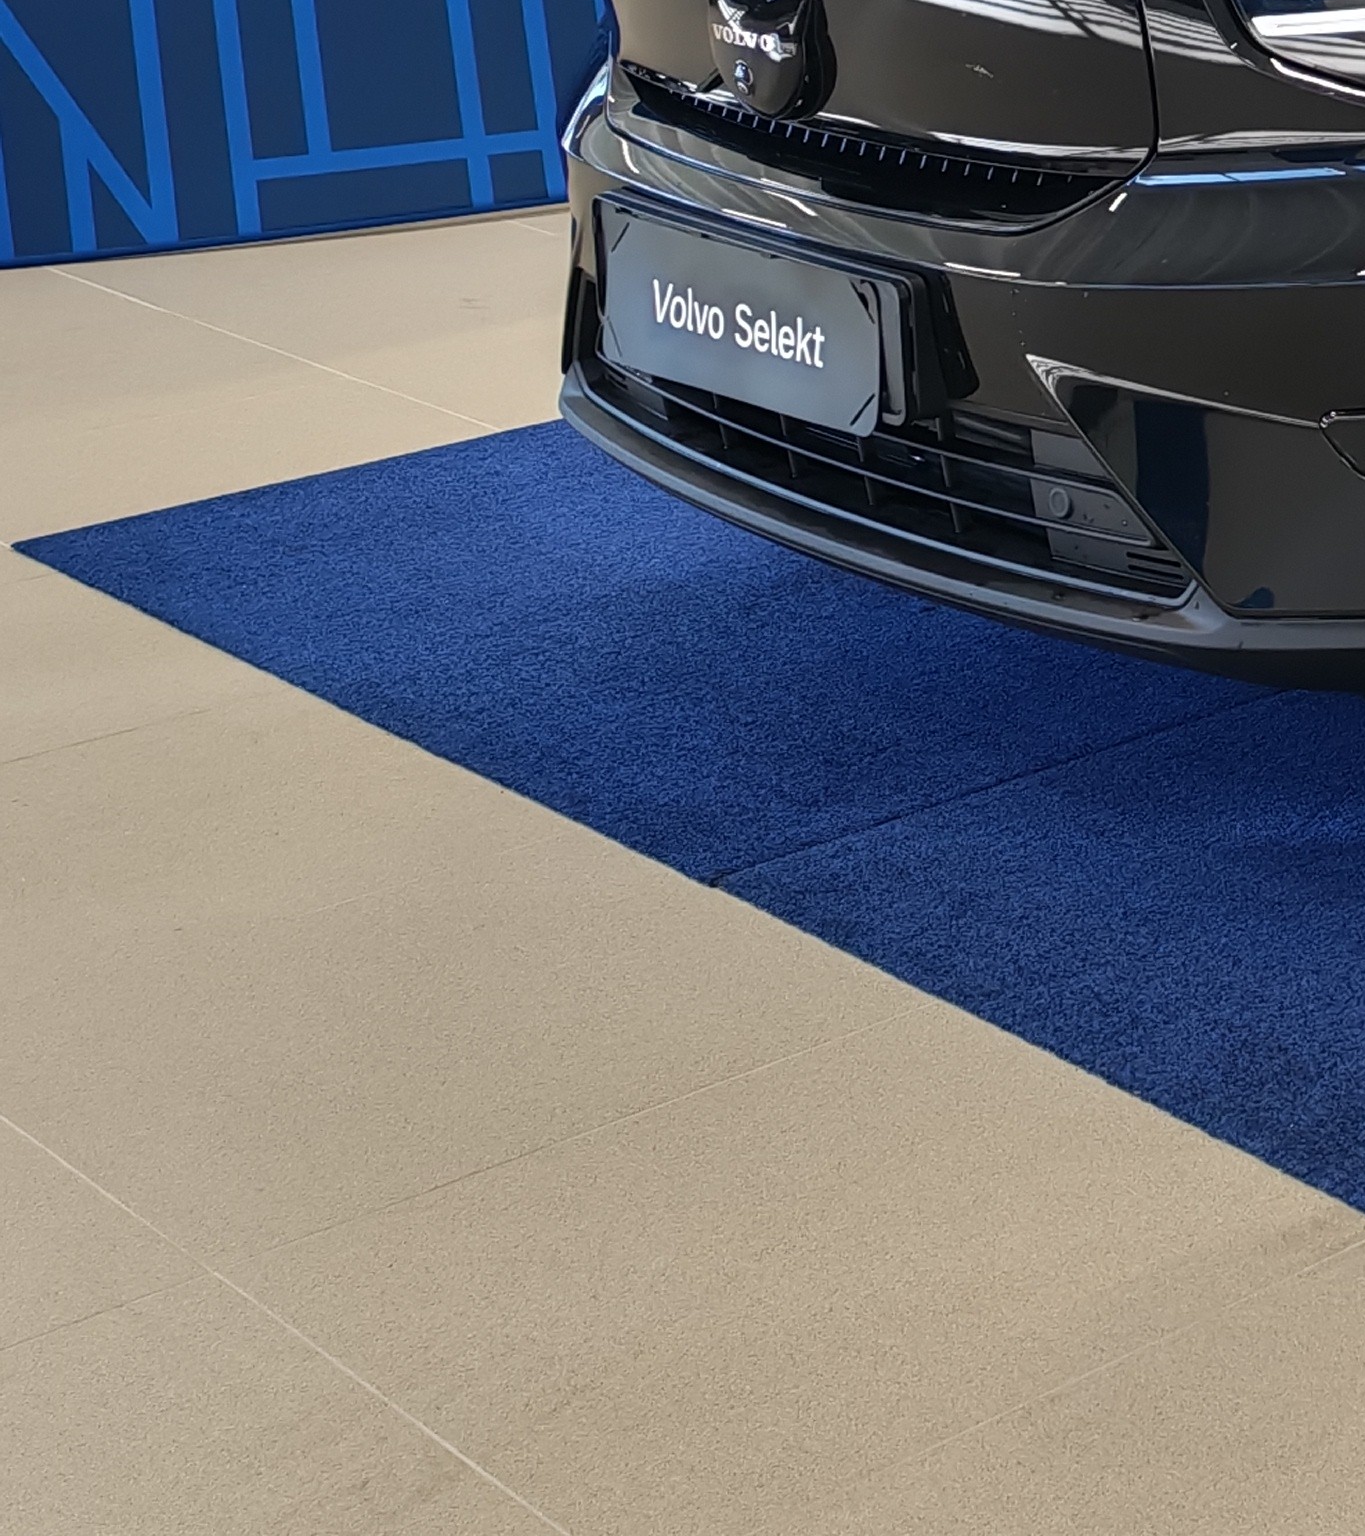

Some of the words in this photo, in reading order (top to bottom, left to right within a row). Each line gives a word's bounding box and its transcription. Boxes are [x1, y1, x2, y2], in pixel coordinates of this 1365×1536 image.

[712, 24, 774, 53] VOLVO
[653, 279, 725, 340] Volvo
[734, 303, 825, 369] Selekt
